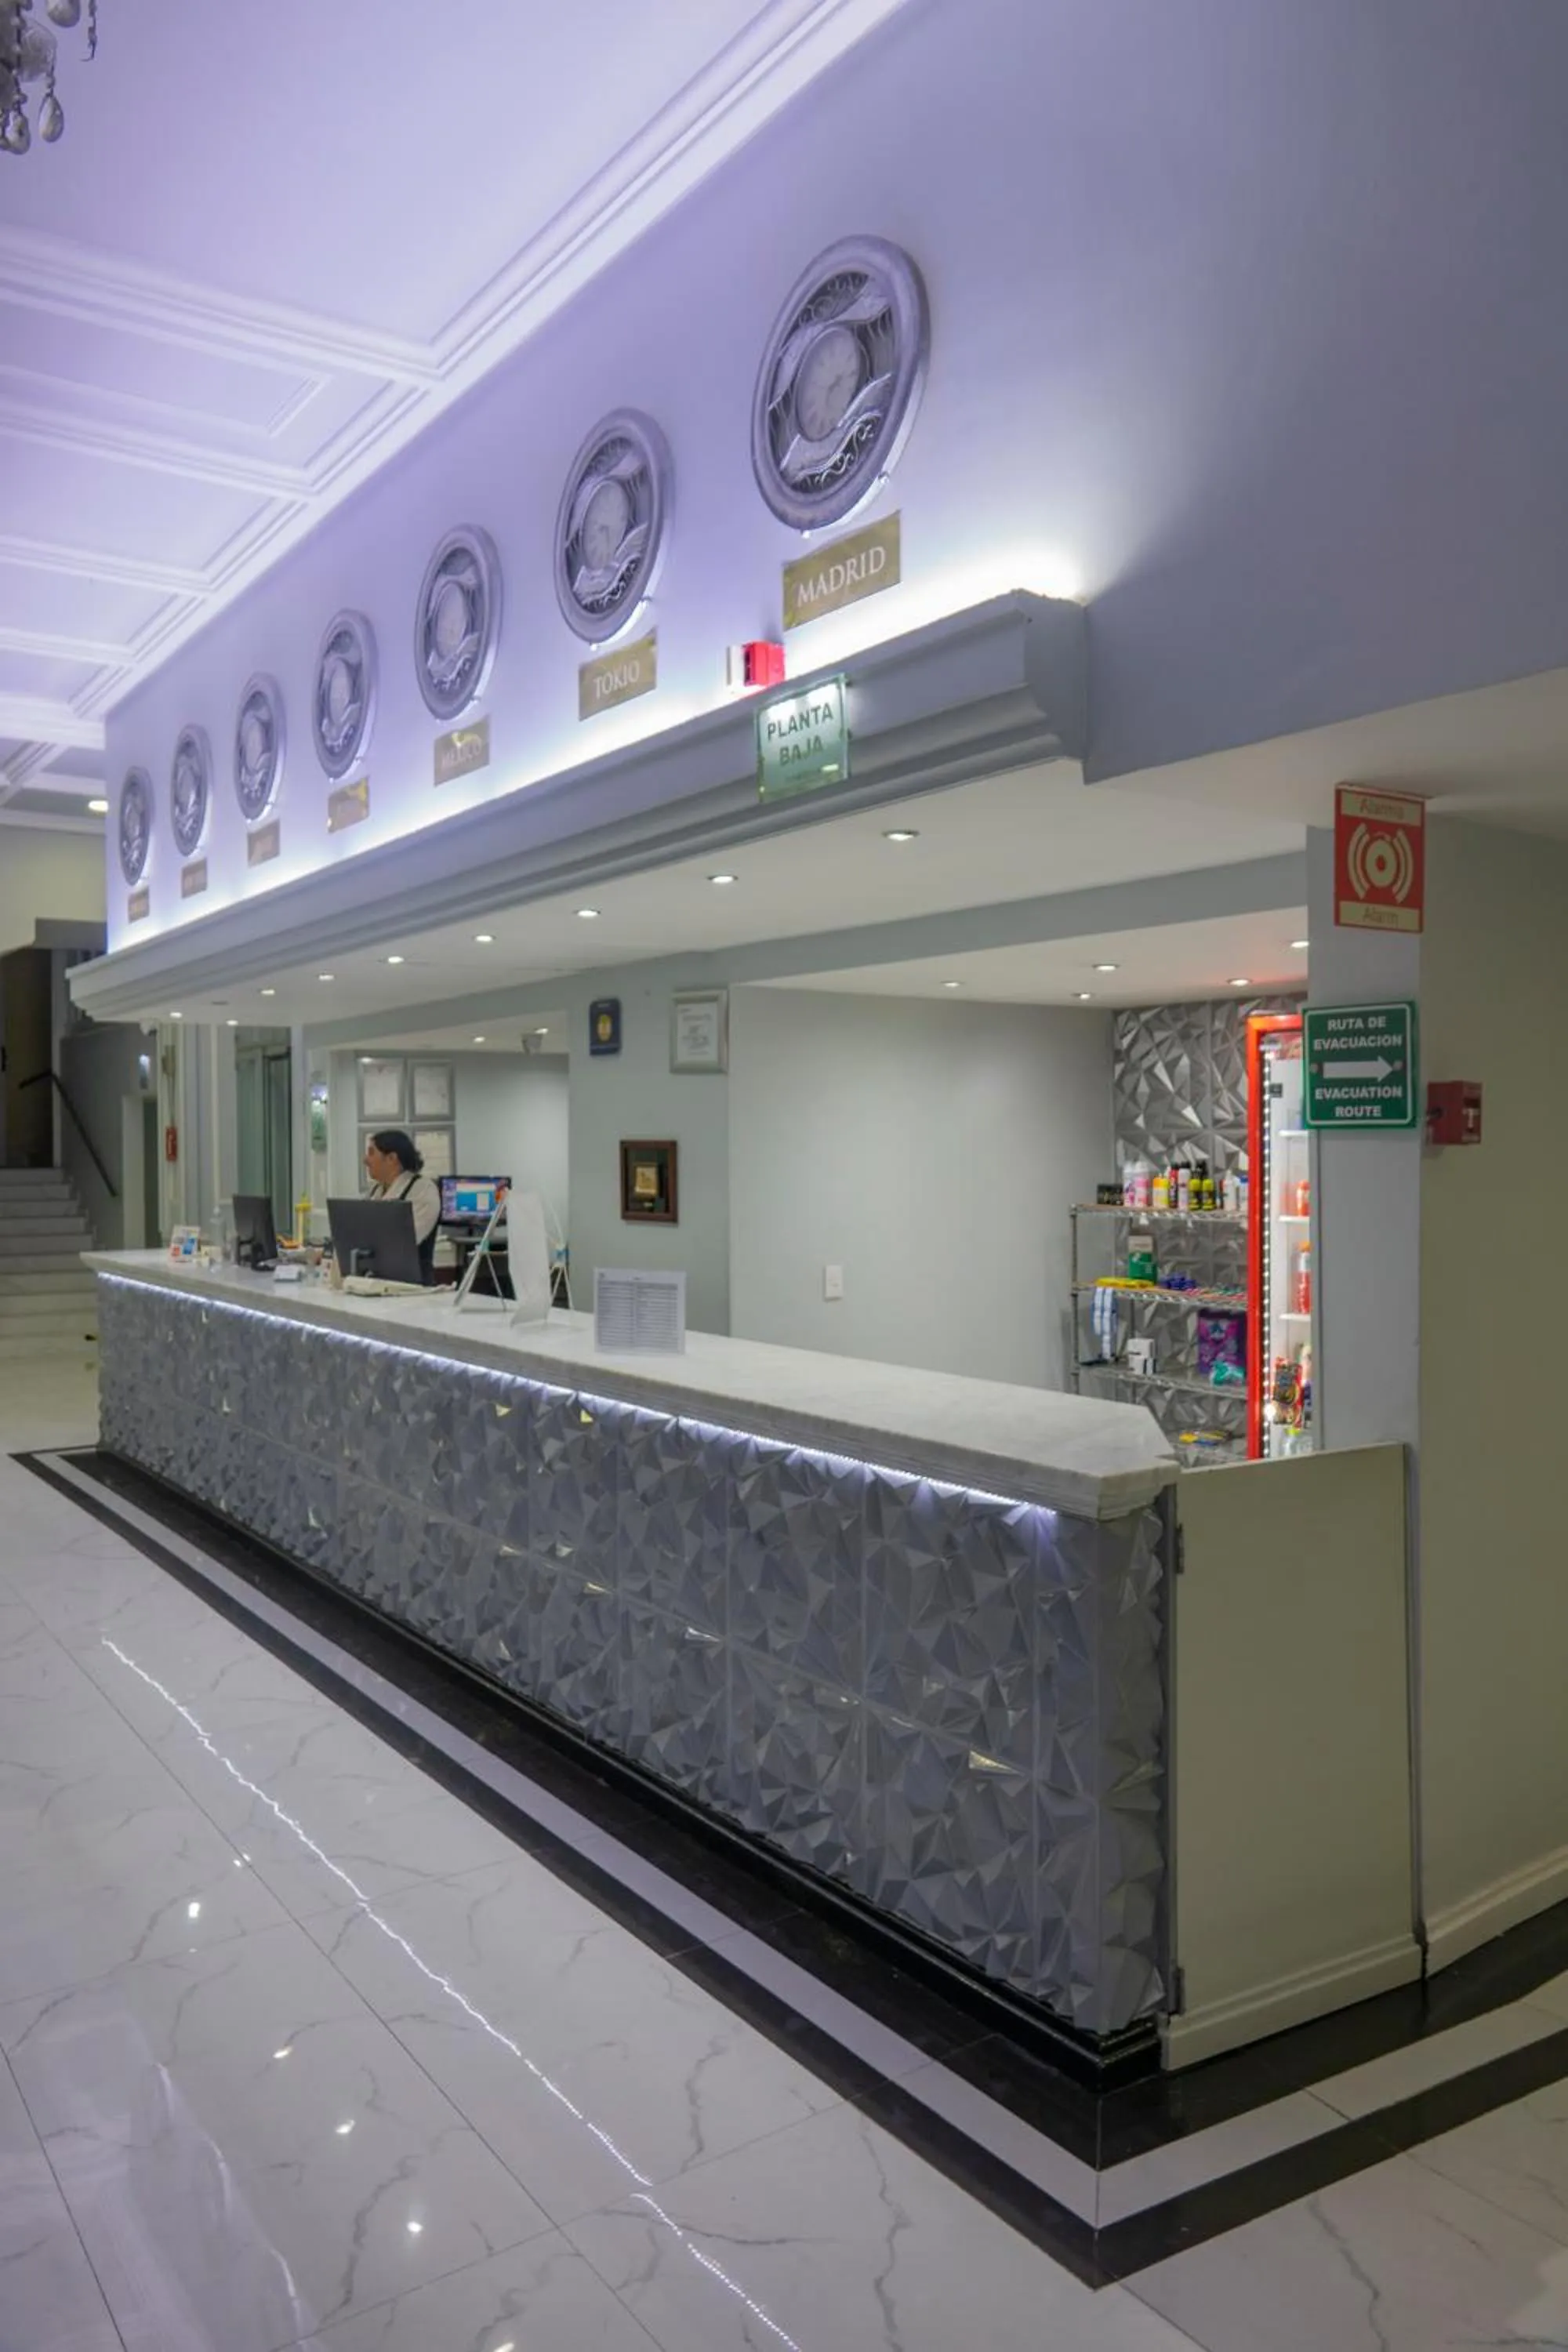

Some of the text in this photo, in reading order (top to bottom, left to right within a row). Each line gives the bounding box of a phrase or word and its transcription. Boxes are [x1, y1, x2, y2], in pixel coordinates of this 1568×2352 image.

[797, 546, 886, 608] MADRID
[593, 660, 640, 700] TOKIO
[768, 702, 833, 741] PLANTA
[779, 735, 823, 767] BAJA
[1363, 906, 1399, 928] Alarm
[1327, 1016, 1386, 1031] RUTA DE
[1313, 1034, 1403, 1051] EVACUACION
[1315, 1086, 1403, 1100] EVACUATION
[1335, 1105, 1382, 1117] ROUTE
